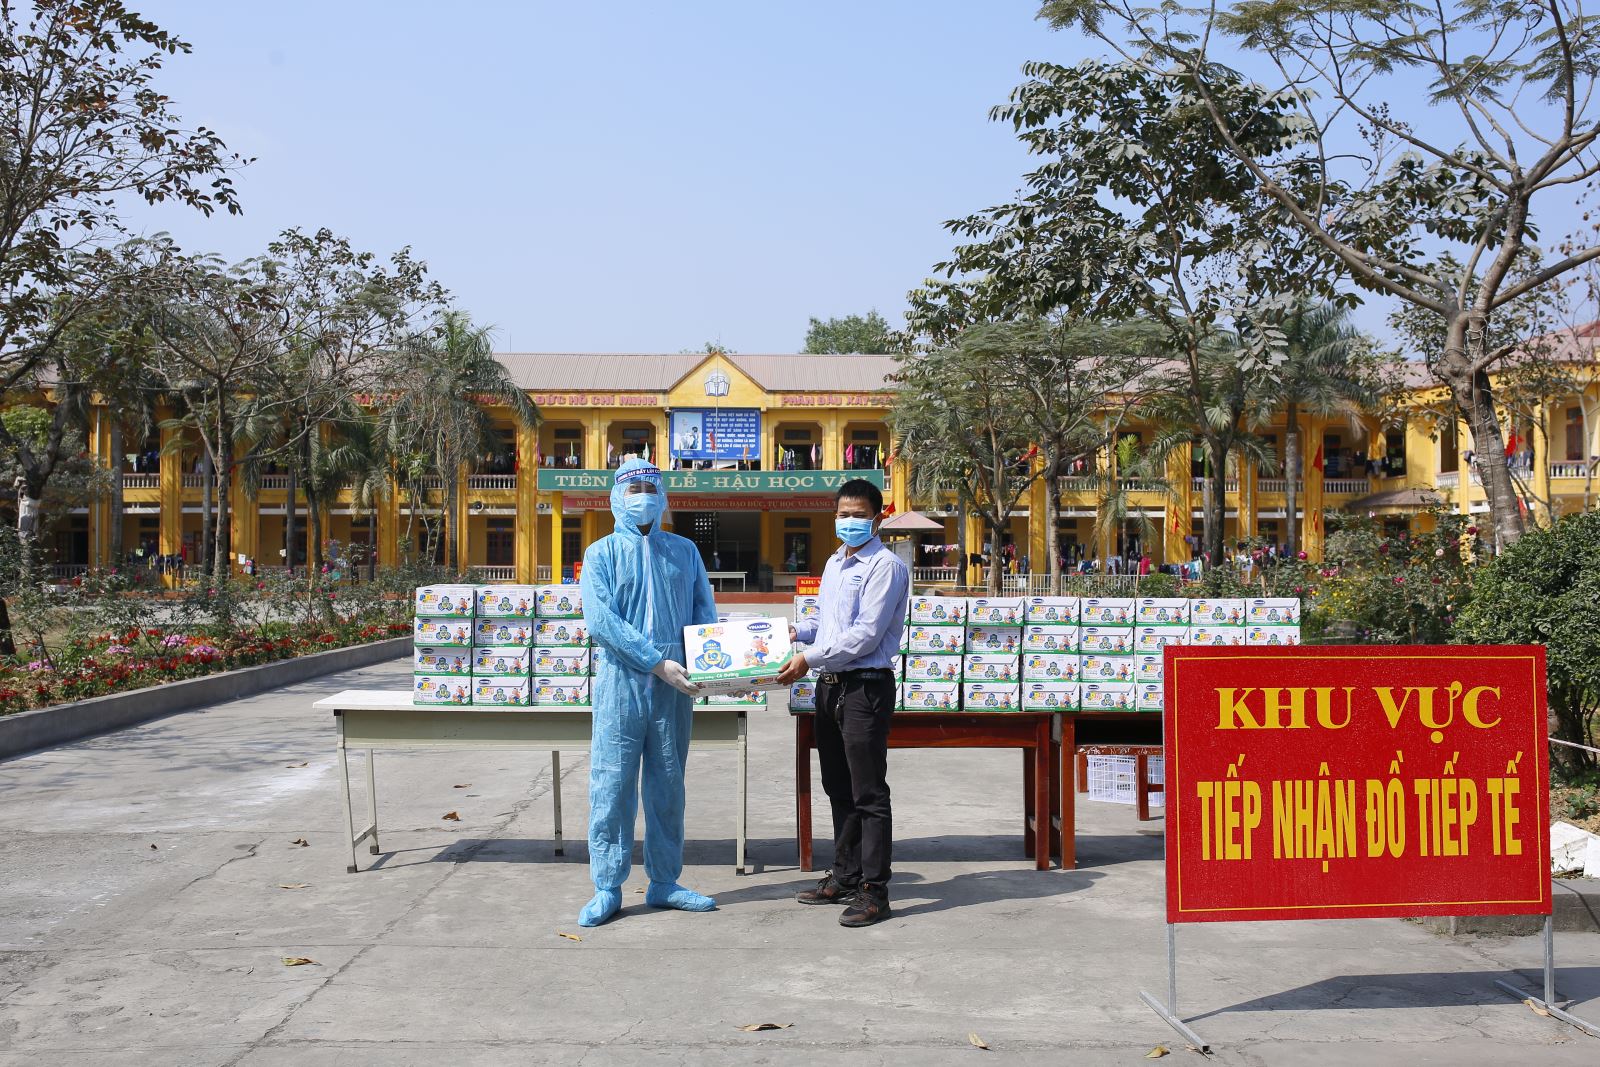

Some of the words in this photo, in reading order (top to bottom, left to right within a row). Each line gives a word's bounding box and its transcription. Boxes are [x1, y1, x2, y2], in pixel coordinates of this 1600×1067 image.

[591, 394, 614, 405] CHÍ
[619, 395, 657, 406] MINH
[555, 472, 608, 487] TIÊN
[669, 471, 697, 488] LỄ
[713, 473, 760, 490] HẬU
[768, 475, 815, 491] HỌC
[1214, 686, 1355, 730] KHU
[1372, 680, 1502, 744] VỰC
[1196, 753, 1262, 861] TIẾP
[1272, 762, 1357, 873] NHẬN
[1365, 750, 1406, 858] ĐỒ
[1414, 751, 1478, 857] TIẾP
[1487, 751, 1524, 856] TẾ
